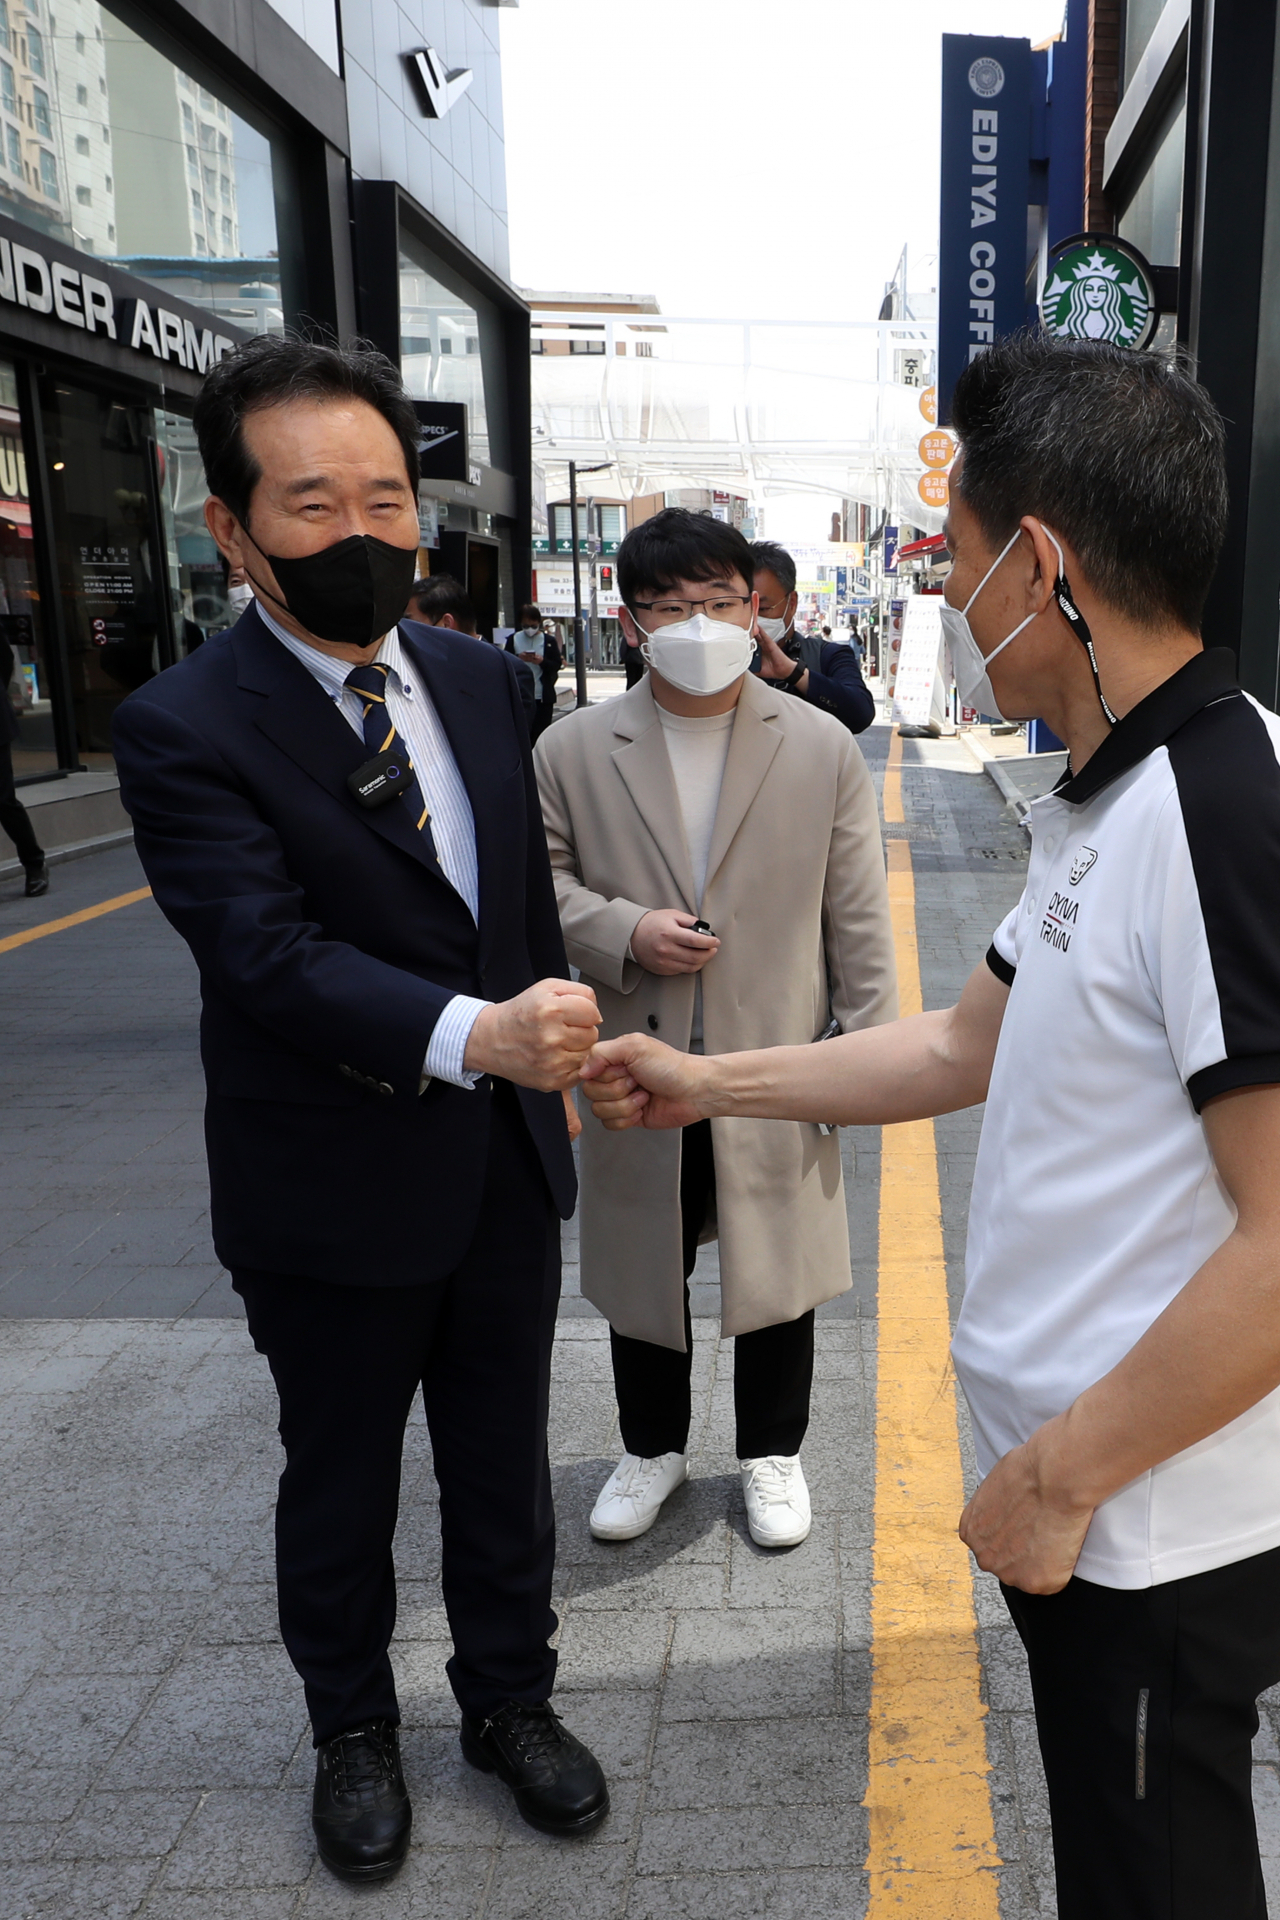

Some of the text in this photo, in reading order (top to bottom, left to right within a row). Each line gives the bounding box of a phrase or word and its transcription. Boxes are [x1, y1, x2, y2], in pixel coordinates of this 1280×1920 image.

[971, 108, 998, 228] EDIYA
[924, 438, 948, 449] 중고폰
[926, 449, 946, 460] 판매
[924, 477, 947, 488] 중고폰
[926, 488, 945, 499] 매입
[1086, 641, 1099, 673] MIZUNO
[1048, 891, 1080, 925] DYNA
[1040, 919, 1072, 953] TRAIN
